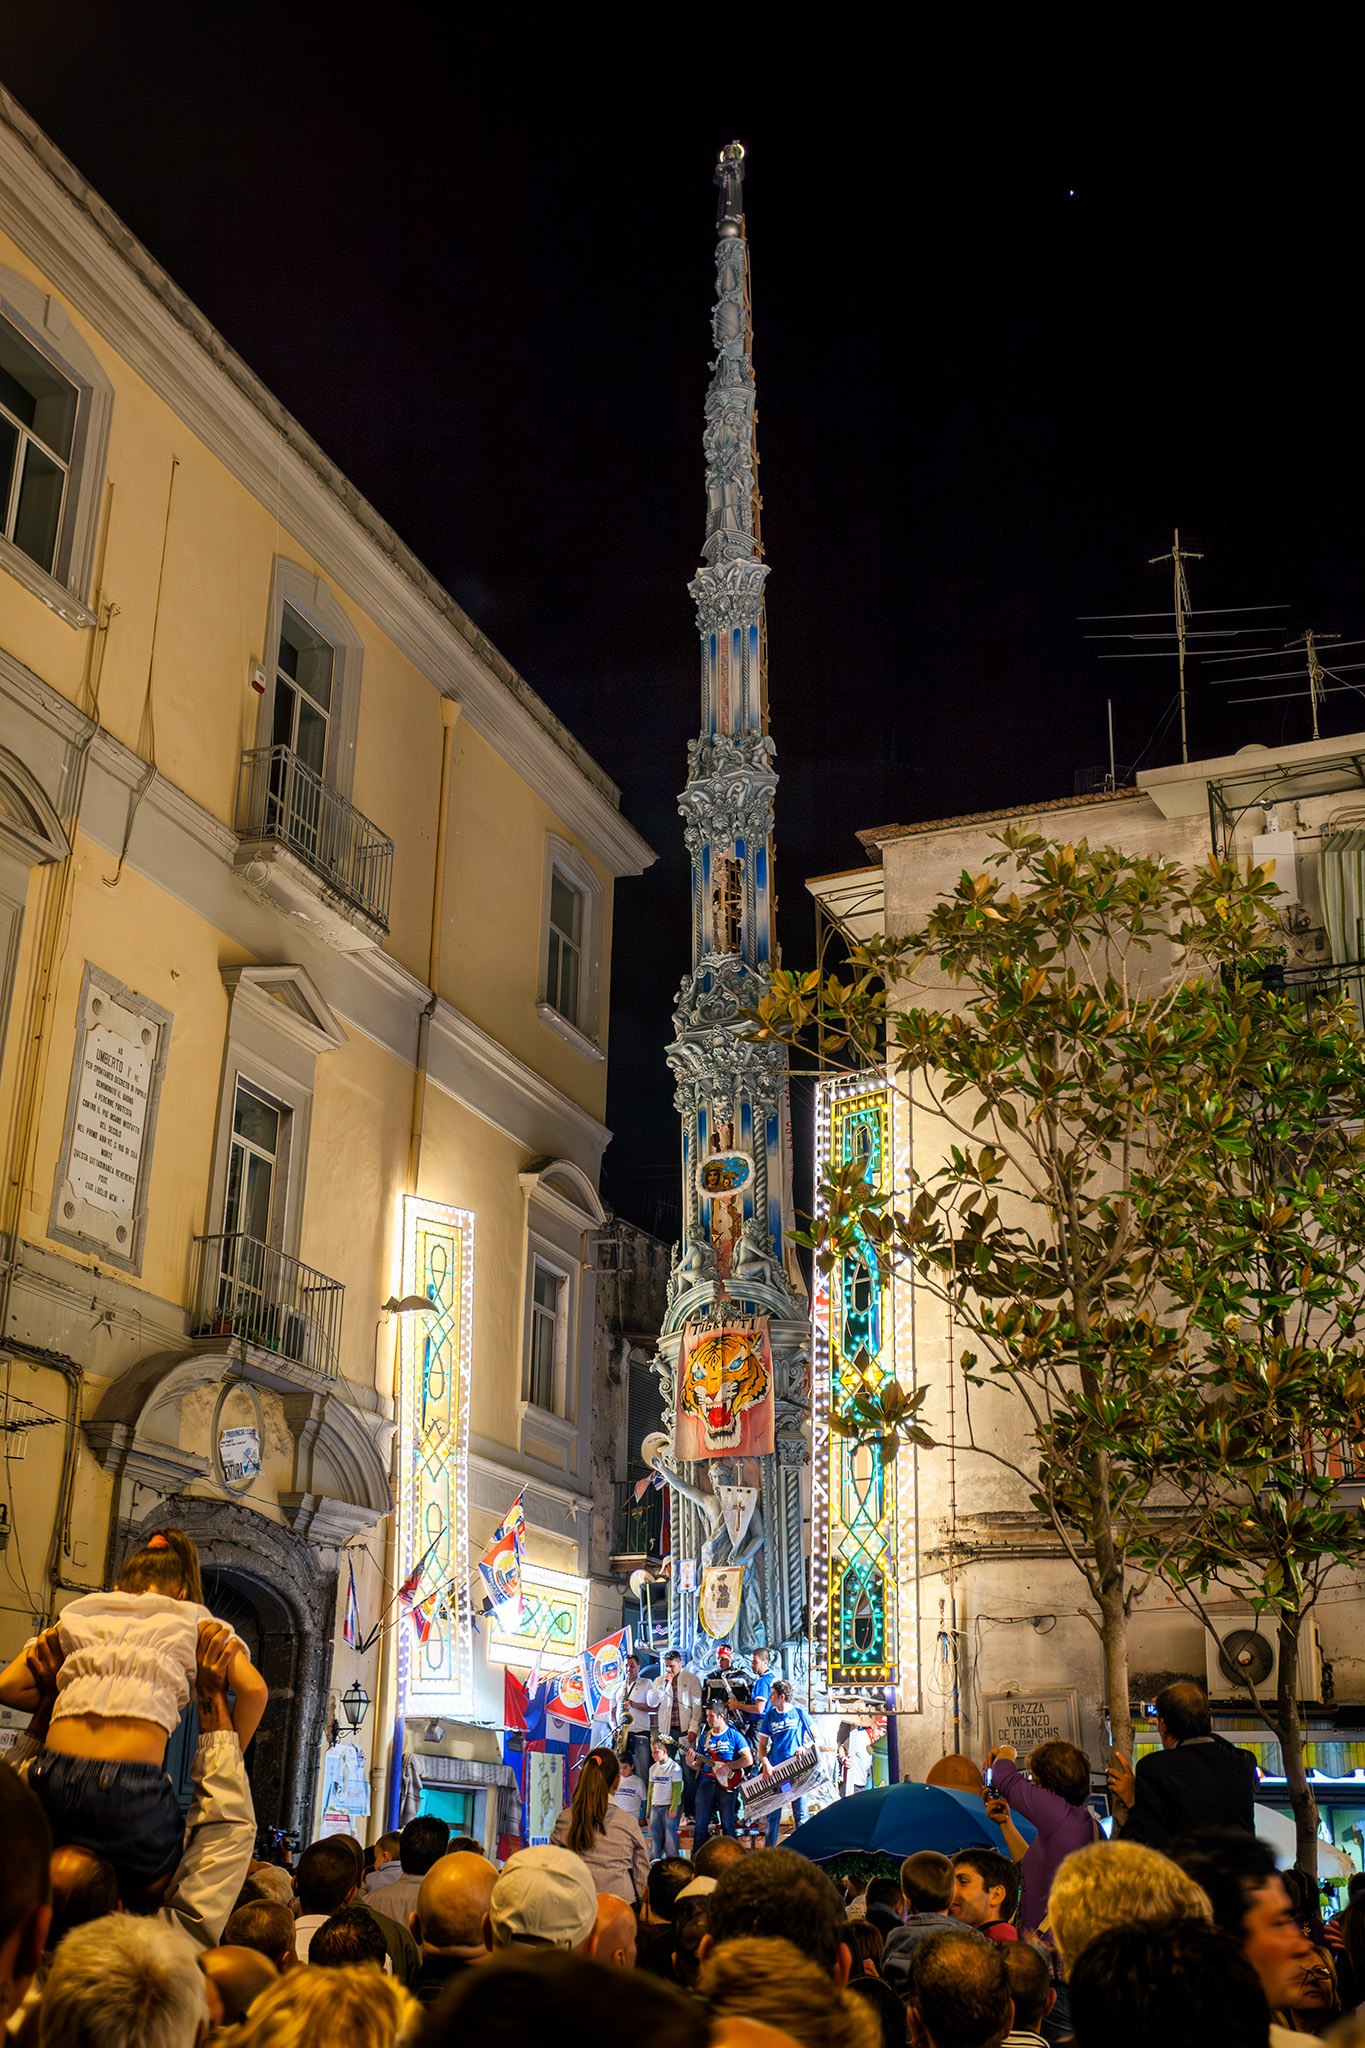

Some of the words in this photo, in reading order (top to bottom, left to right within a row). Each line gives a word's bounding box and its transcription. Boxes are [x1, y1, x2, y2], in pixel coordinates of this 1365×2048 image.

[85, 1059, 93, 1070] PER
[96, 1048, 124, 1073] UMBERTO
[1012, 1702, 1045, 1715] PIAZZA
[1006, 1714, 1050, 1727] VINCENZO
[998, 1729, 1010, 1740] DE
[1013, 1727, 1059, 1740] FRANCHIS
